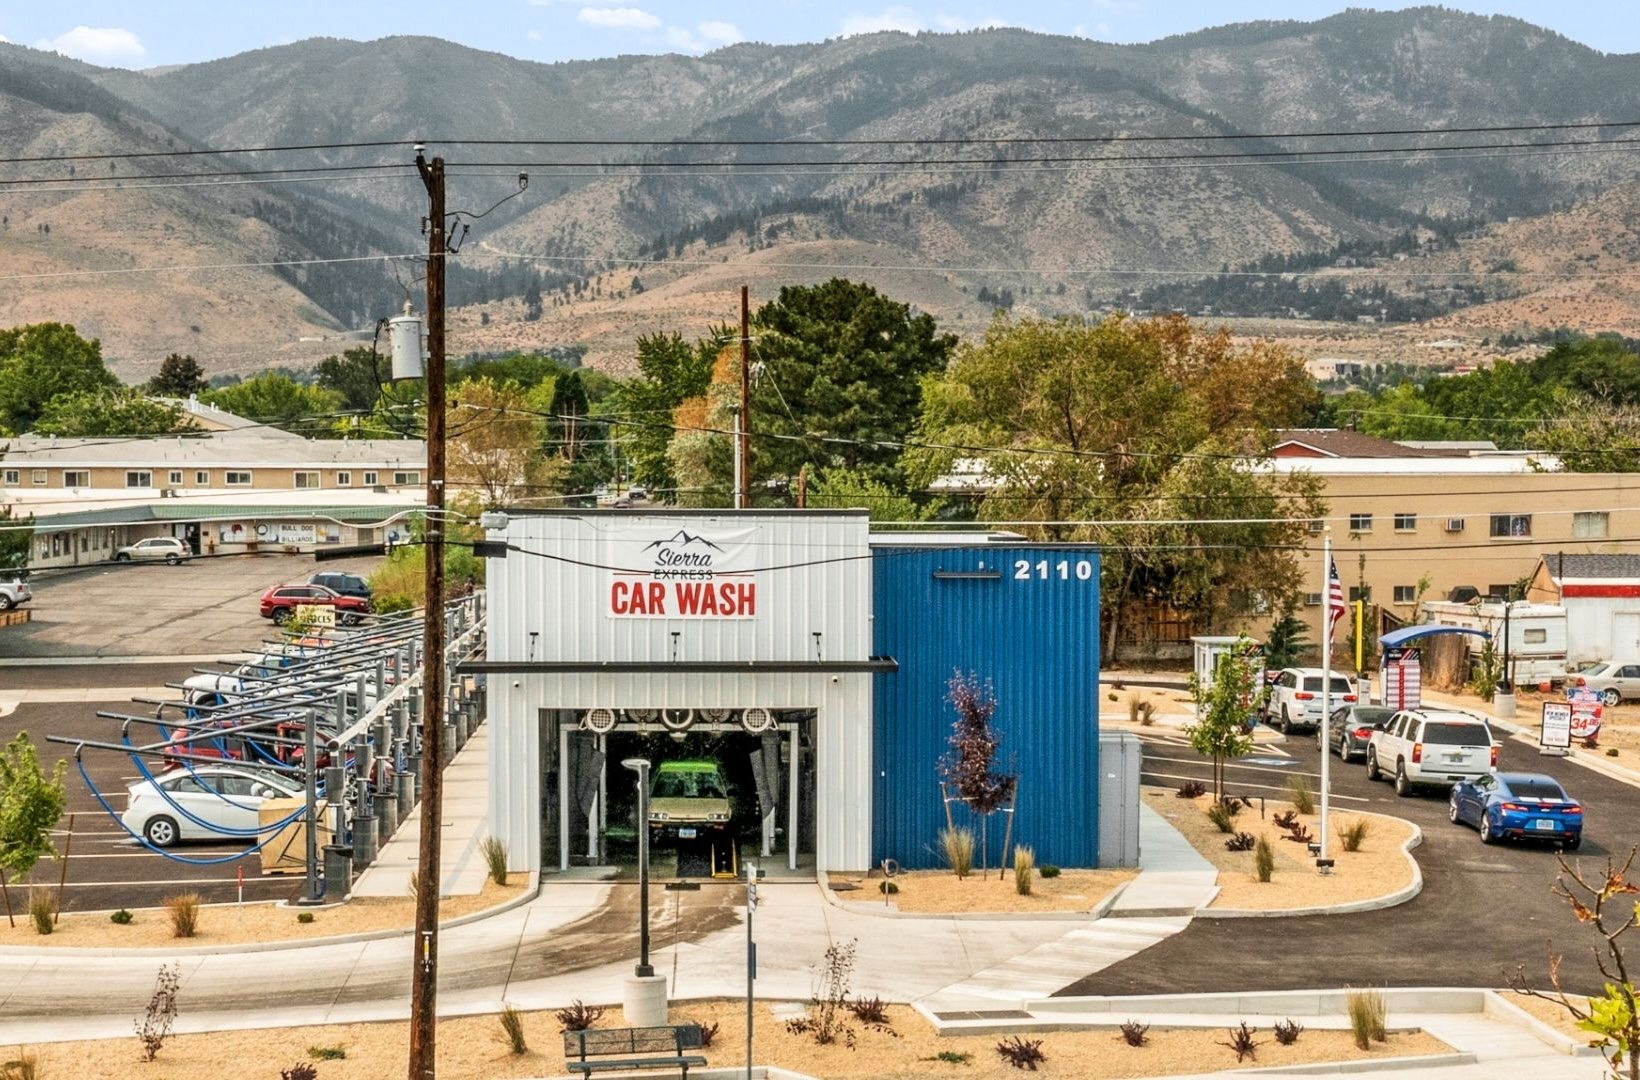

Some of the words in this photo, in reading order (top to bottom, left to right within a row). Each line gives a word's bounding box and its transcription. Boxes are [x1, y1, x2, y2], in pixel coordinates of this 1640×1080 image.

[655, 547, 712, 566] Sierra
[654, 569, 713, 580] EXPRESS
[1014, 559, 1092, 580] 2110
[611, 581, 665, 615] CAR
[675, 582, 756, 616] WASH
